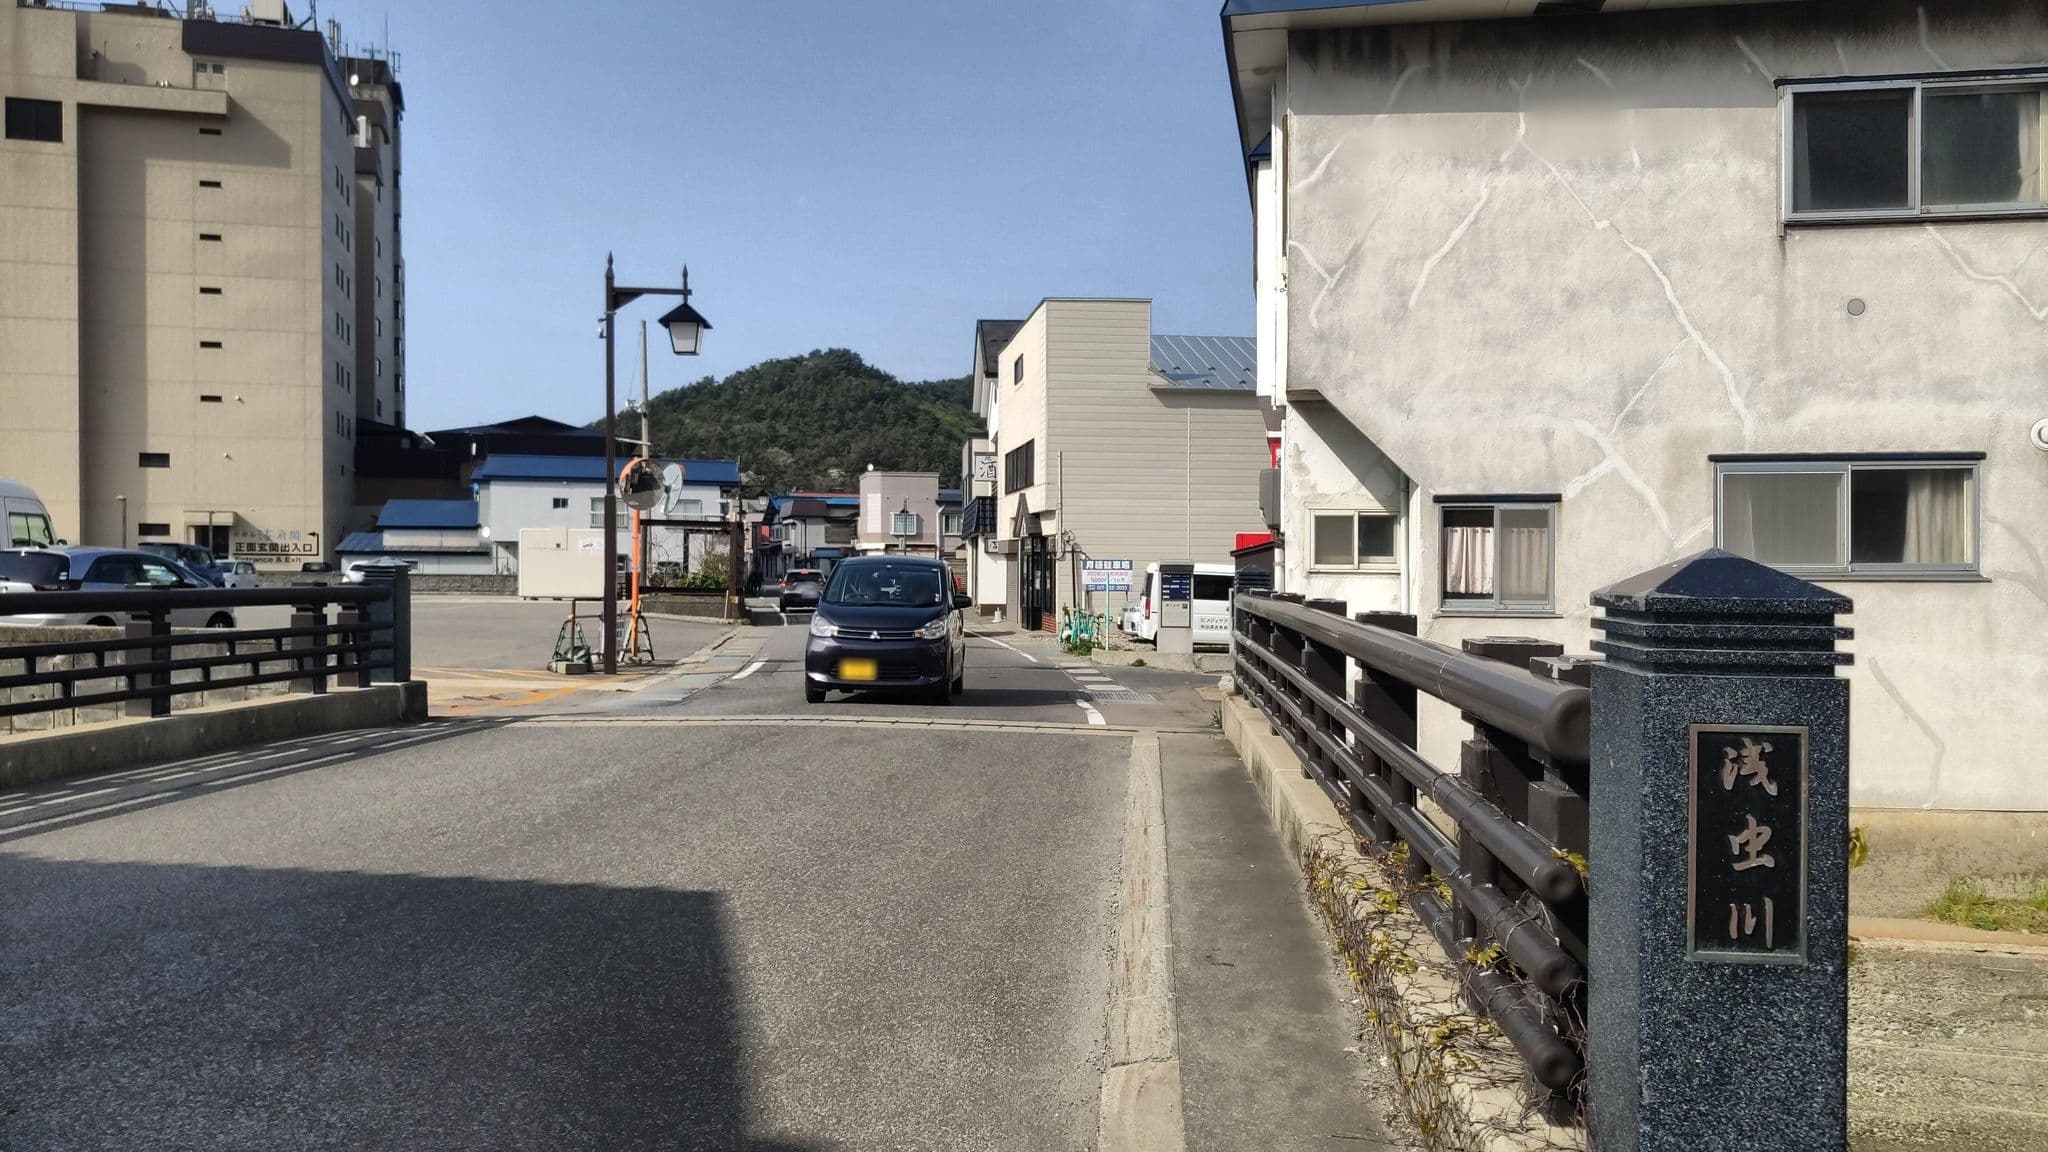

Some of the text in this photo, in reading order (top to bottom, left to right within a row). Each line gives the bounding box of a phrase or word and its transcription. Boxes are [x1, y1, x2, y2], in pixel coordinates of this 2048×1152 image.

[235, 542, 312, 552] 正面玄関出入口
[1722, 737, 1778, 949] 浅虫川
